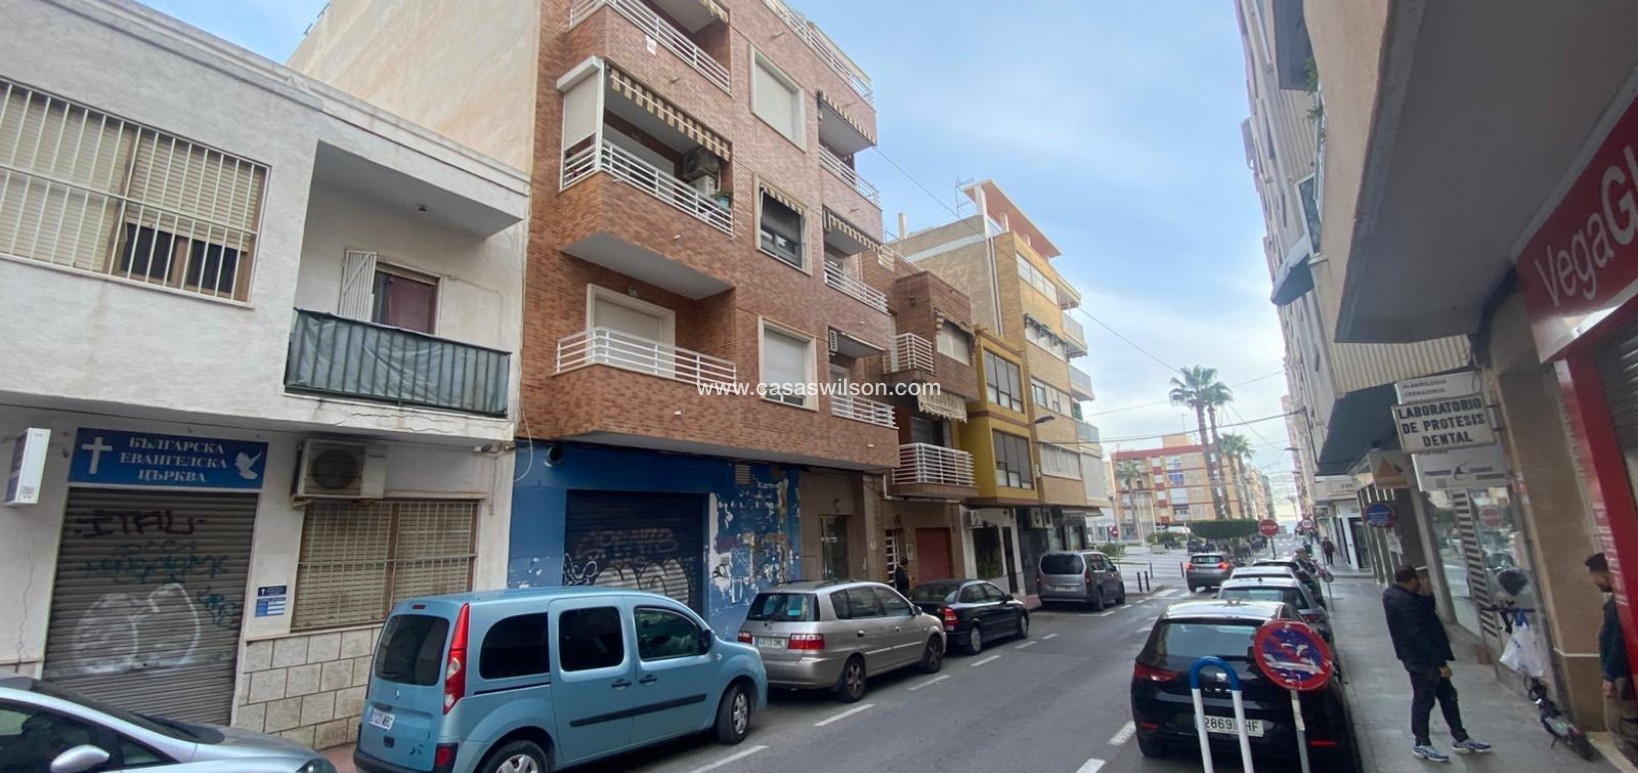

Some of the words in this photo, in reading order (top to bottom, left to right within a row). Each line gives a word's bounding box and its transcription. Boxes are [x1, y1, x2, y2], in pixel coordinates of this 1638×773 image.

[1397, 398, 1482, 420] LABORATORIO
[1401, 422, 1419, 435] DE
[1422, 413, 1486, 432] PROTESIS
[128, 436, 225, 455] БЪЛГАРСКА
[1422, 431, 1474, 448] DENTAL
[120, 452, 228, 469] ЕВАНГЕЛСКА
[137, 469, 207, 483] ЦЪРКВА
[1260, 524, 1278, 532] STOP
[1203, 716, 1233, 730] 2869
